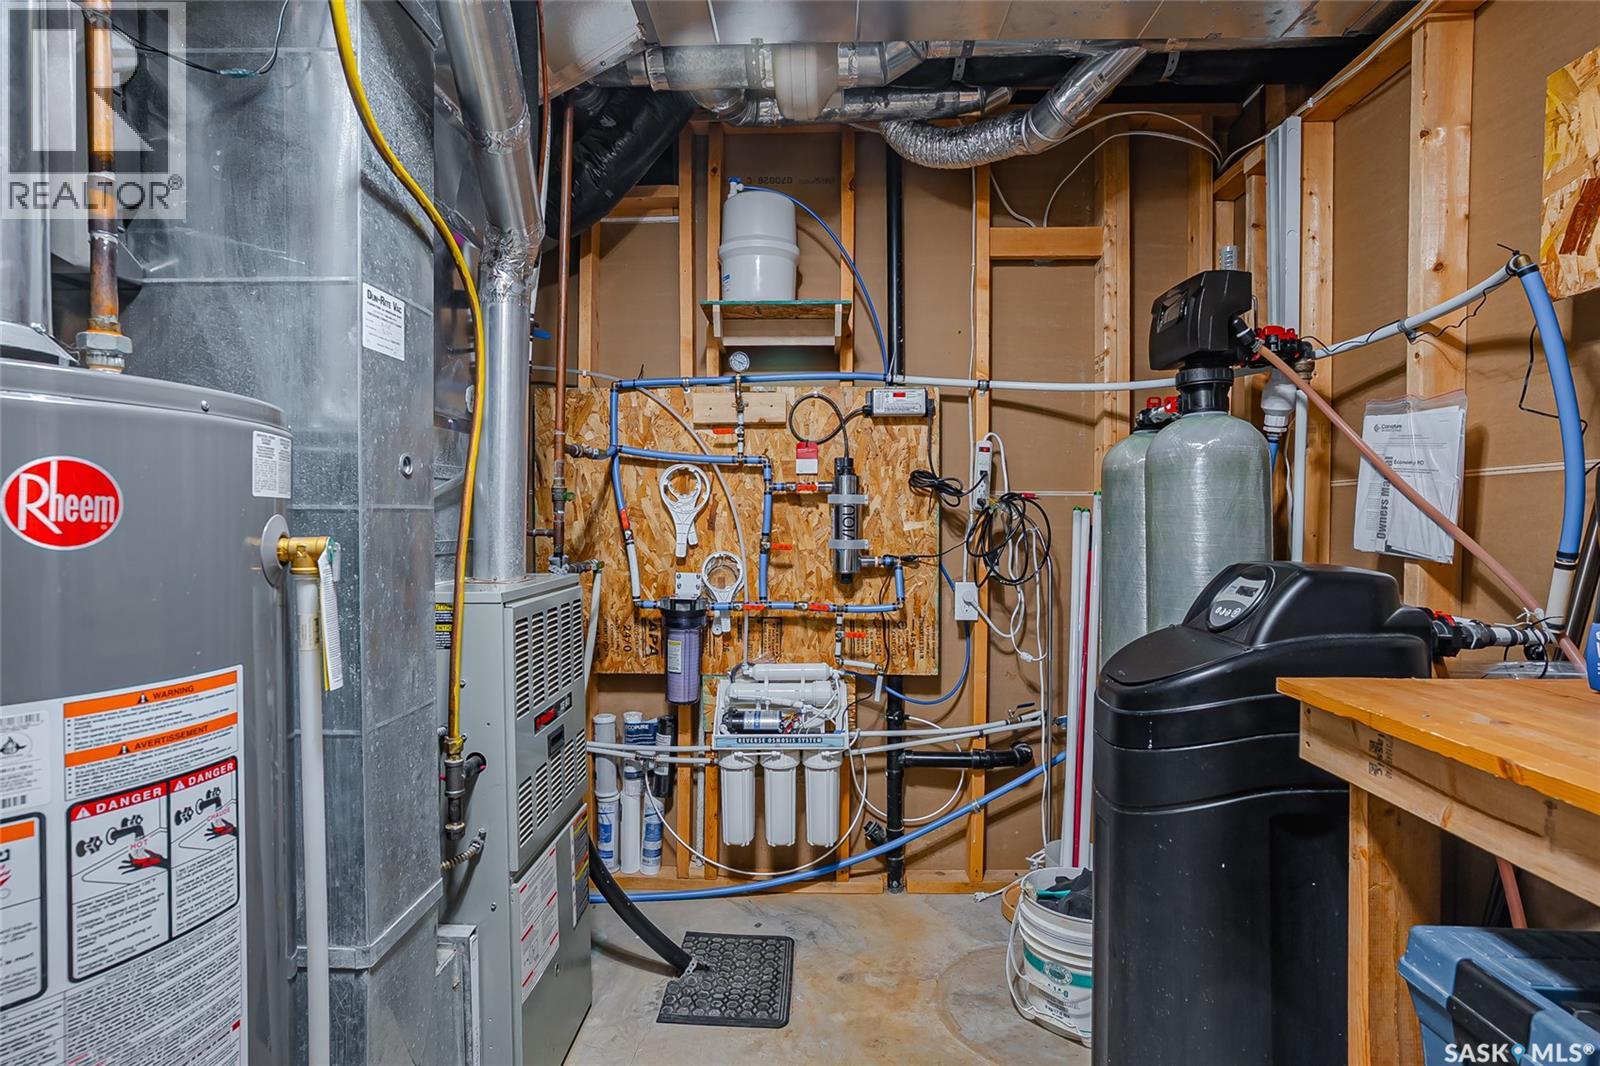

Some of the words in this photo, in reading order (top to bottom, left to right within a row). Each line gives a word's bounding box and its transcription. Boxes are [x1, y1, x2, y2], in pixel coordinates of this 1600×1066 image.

[1380, 456, 1394, 497] Maal
[18, 460, 116, 535] Rheem
[1376, 499, 1390, 540] Owners
[152, 685, 195, 700] WARNING
[134, 725, 209, 751] AVERTISSEMENT
[188, 763, 234, 786] DANGER
[95, 787, 163, 814] DANGER
[207, 807, 232, 822] CHAUDE
[130, 839, 149, 850] HOT
